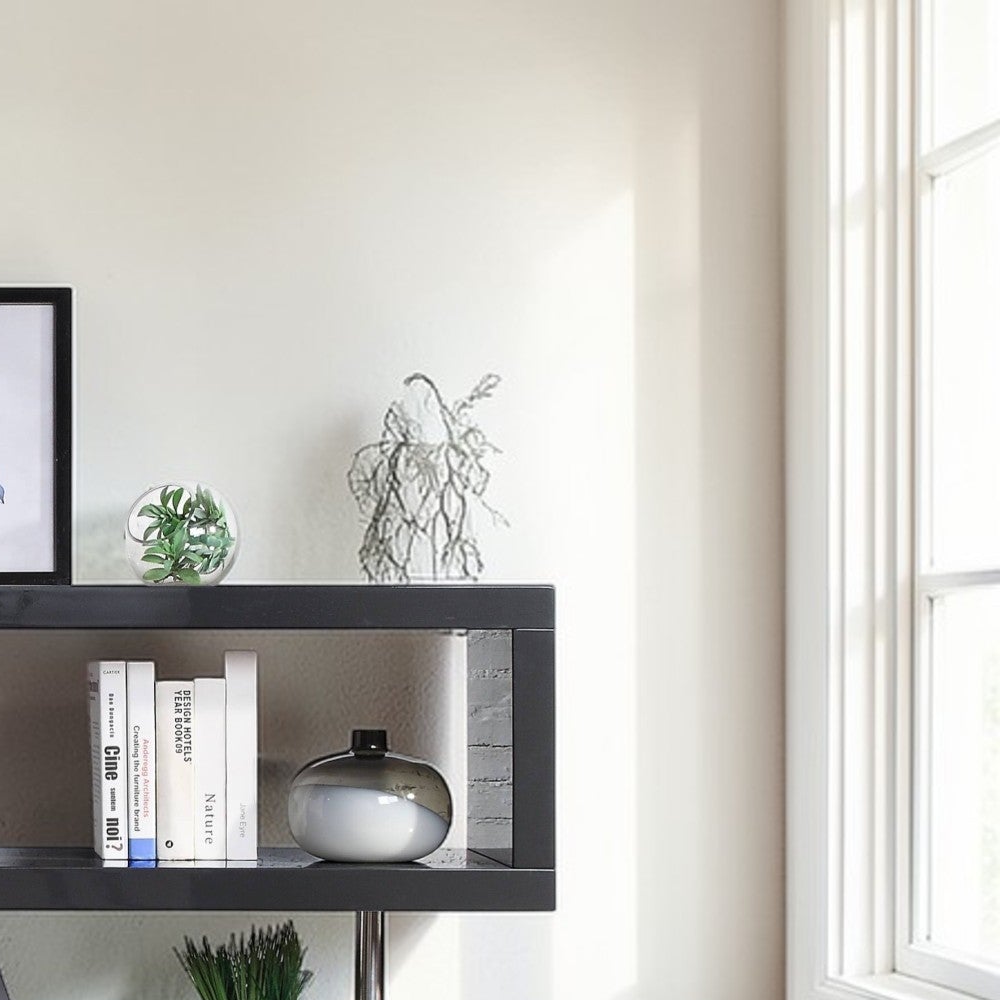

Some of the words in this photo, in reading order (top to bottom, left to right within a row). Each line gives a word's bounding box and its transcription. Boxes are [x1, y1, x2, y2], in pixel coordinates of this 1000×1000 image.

[174, 690, 183, 714] YEAR
[183, 690, 192, 723] DESIGN
[132, 724, 141, 759] Creating
[141, 739, 149, 777] Anderegg
[183, 727, 192, 762] HOTELS
[104, 745, 121, 781] Cine
[204, 793, 216, 845] Nature
[239, 803, 247, 820] Jane
[106, 818, 123, 851] noi?
[238, 821, 247, 838] Eyre
